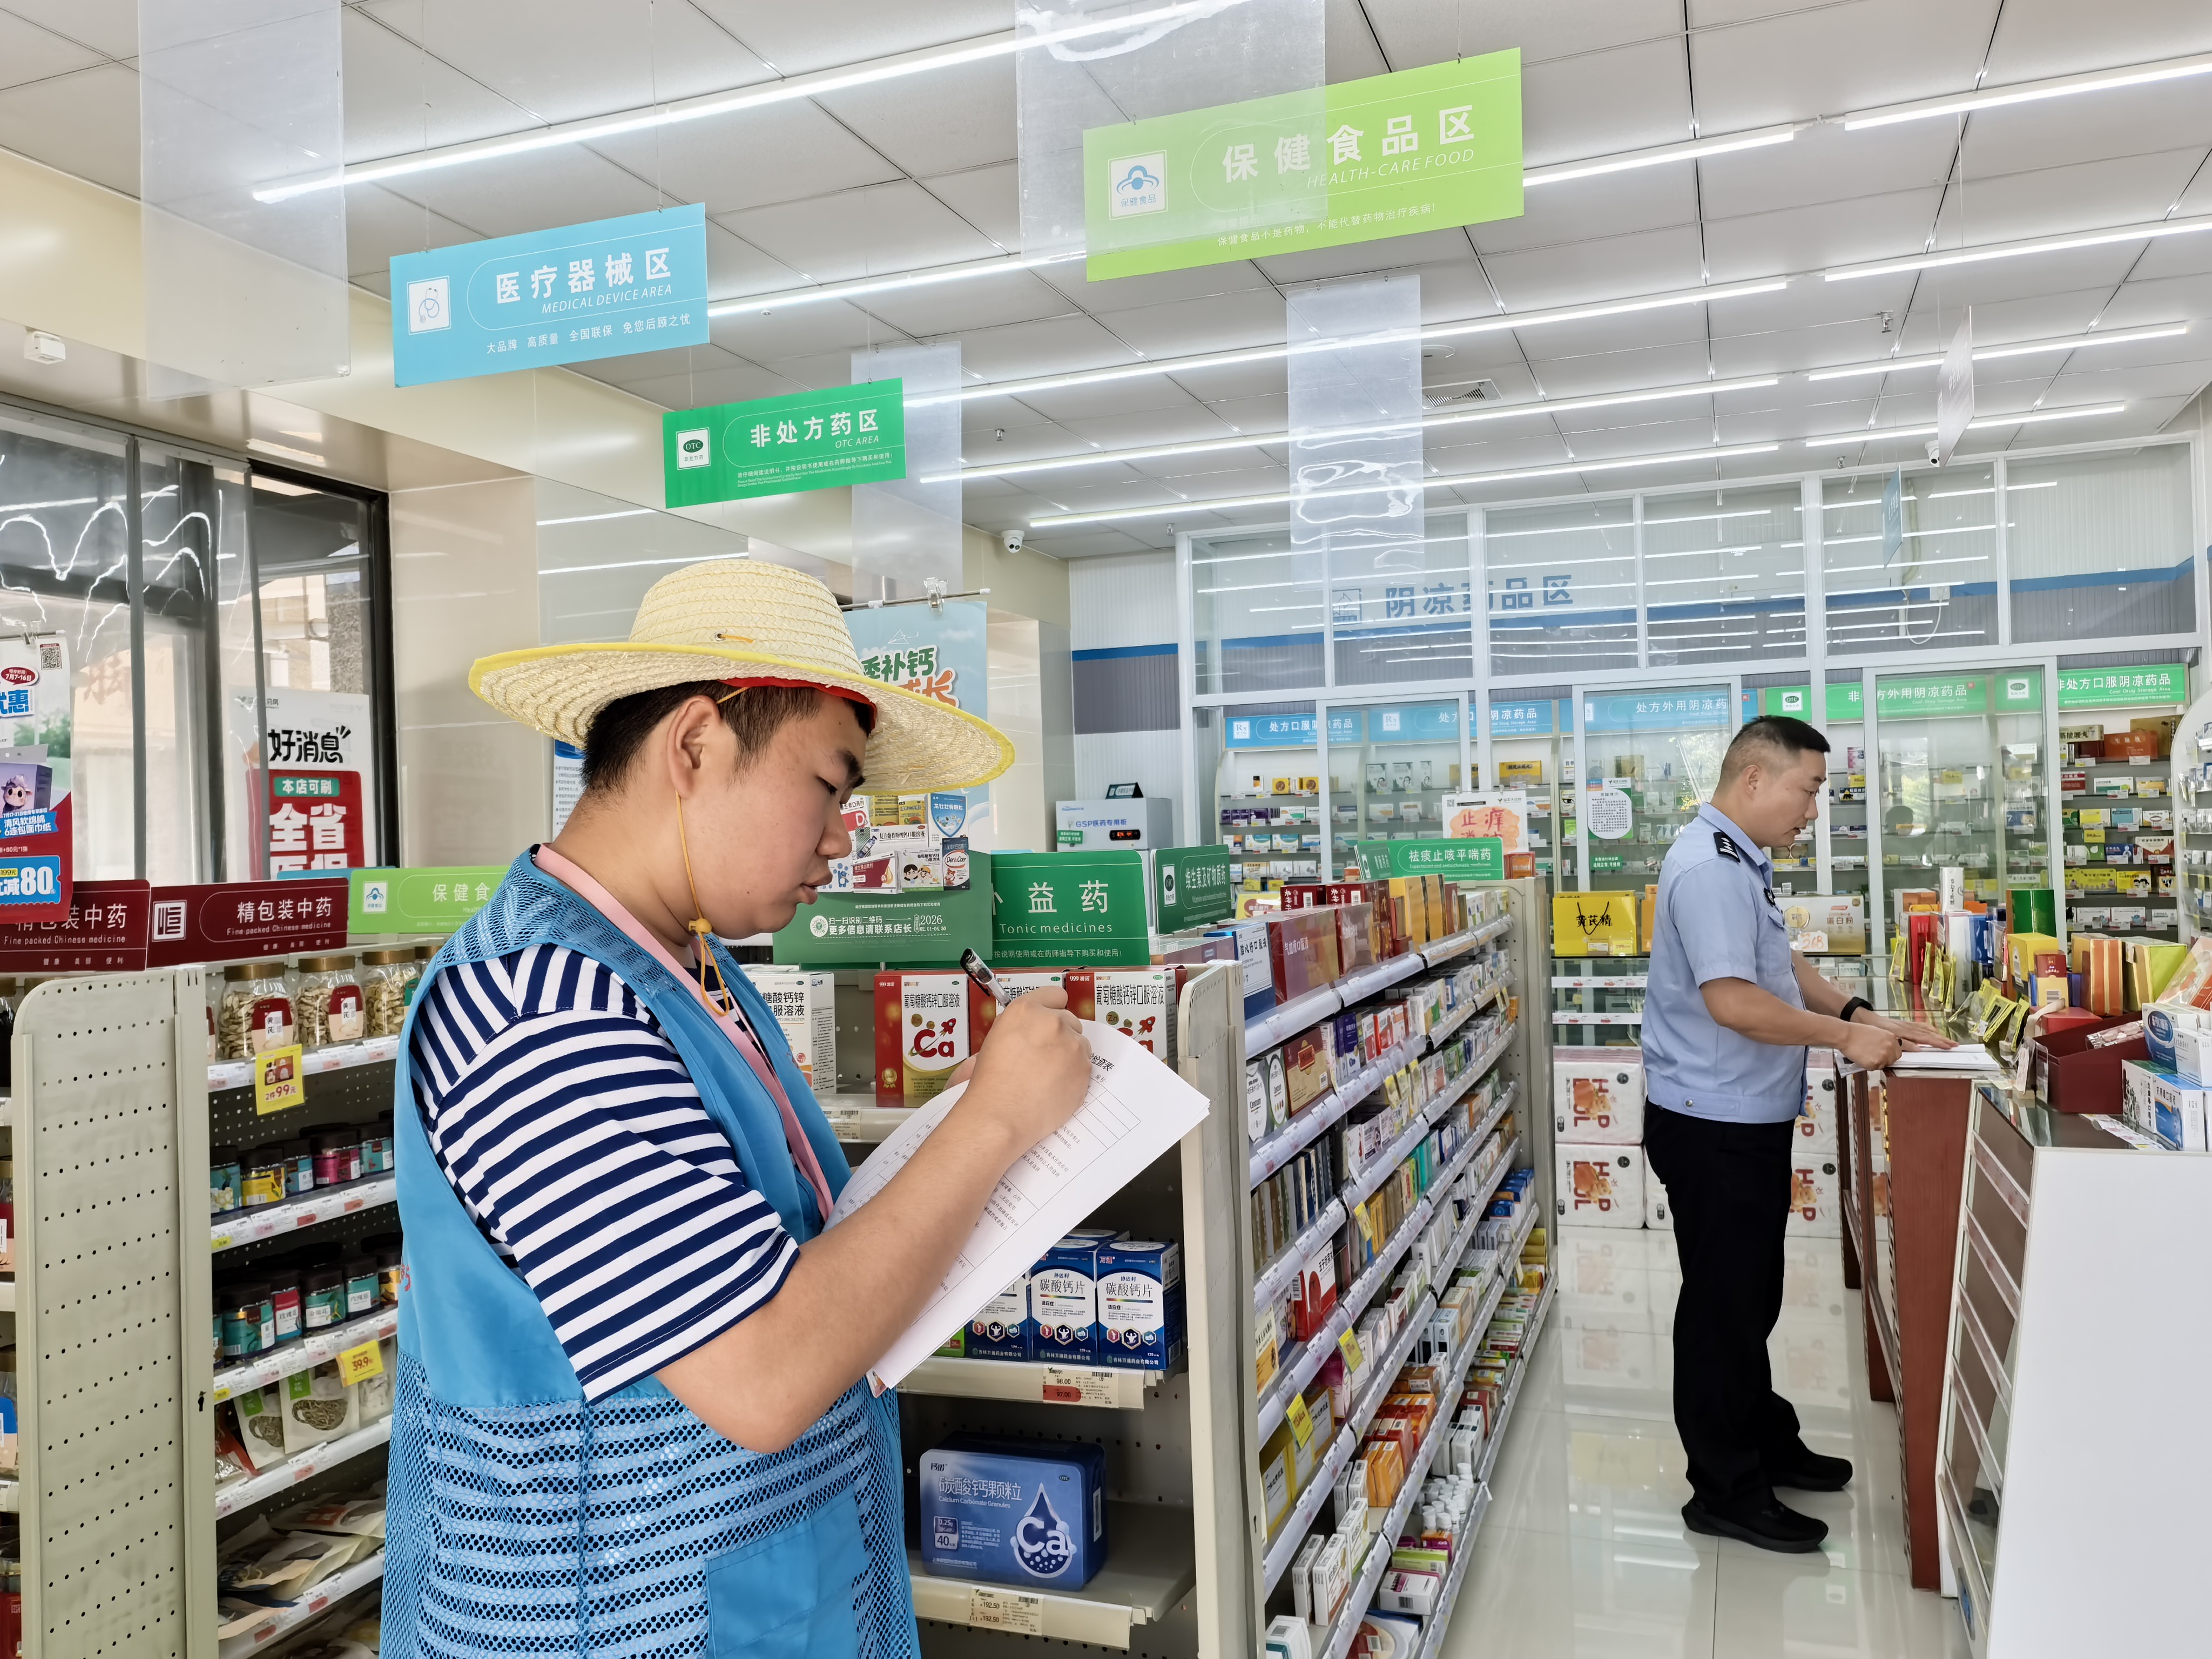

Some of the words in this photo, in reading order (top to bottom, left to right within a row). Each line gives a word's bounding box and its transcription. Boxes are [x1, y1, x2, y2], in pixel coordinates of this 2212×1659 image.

[1222, 105, 1474, 183] 保健食品区
[1307, 160, 1422, 189] HEALTH-CARE
[1425, 147, 1475, 169] FOOD
[496, 247, 671, 304] 医疗器械区
[542, 296, 593, 314] MEDICAL
[596, 289, 638, 306] DEVICE
[641, 284, 672, 300] AREA
[487, 339, 517, 354] 大品牌
[527, 333, 558, 348] 高质量
[569, 325, 613, 342] 全国联保
[623, 314, 691, 334] 免您后顾之忧
[750, 409, 878, 448] 非处方药区
[685, 441, 701, 450] OTC
[835, 437, 853, 449] OTC
[856, 435, 879, 446] AREA
[1848, 685, 1967, 702] 非方外用阴凉药品
[268, 729, 343, 764] 好消息
[282, 779, 332, 794] 本店可刷
[269, 803, 346, 852] 全省
[1409, 848, 1491, 863] 祛痰止咳平喘药
[433, 882, 490, 902] 保健食
[237, 896, 332, 924] 精包装中药
[828, 916, 882, 925] 扫一扫识别二维码
[920, 915, 942, 925] 2026
[999, 923, 1036, 934] Tonic
[1041, 922, 1113, 933] medicines
[227, 927, 244, 936] Fine
[246, 926, 269, 935] packed
[829, 924, 912, 935] 更多信息请联系店长
[4, 936, 21, 945] Fine
[25, 935, 51, 945] packed
[55, 935, 85, 944] Chinese
[89, 935, 125, 943] medicine
[904, 993, 960, 1008] 葡萄糖酸钙锌口服溶液
[1096, 984, 1164, 1006] 葡萄糖酸钙锌口服溶液
[770, 1004, 805, 1016] 服溶液
[914, 1029, 954, 1057] Ca
[1040, 1279, 1085, 1294] 碳酸钙片
[1106, 1283, 1152, 1298] 碳酸钙片
[939, 1476, 1022, 1501] 碳酸钙颗粒
[960, 1498, 987, 1506] Carbonate
[1016, 1516, 1069, 1557] Ca
